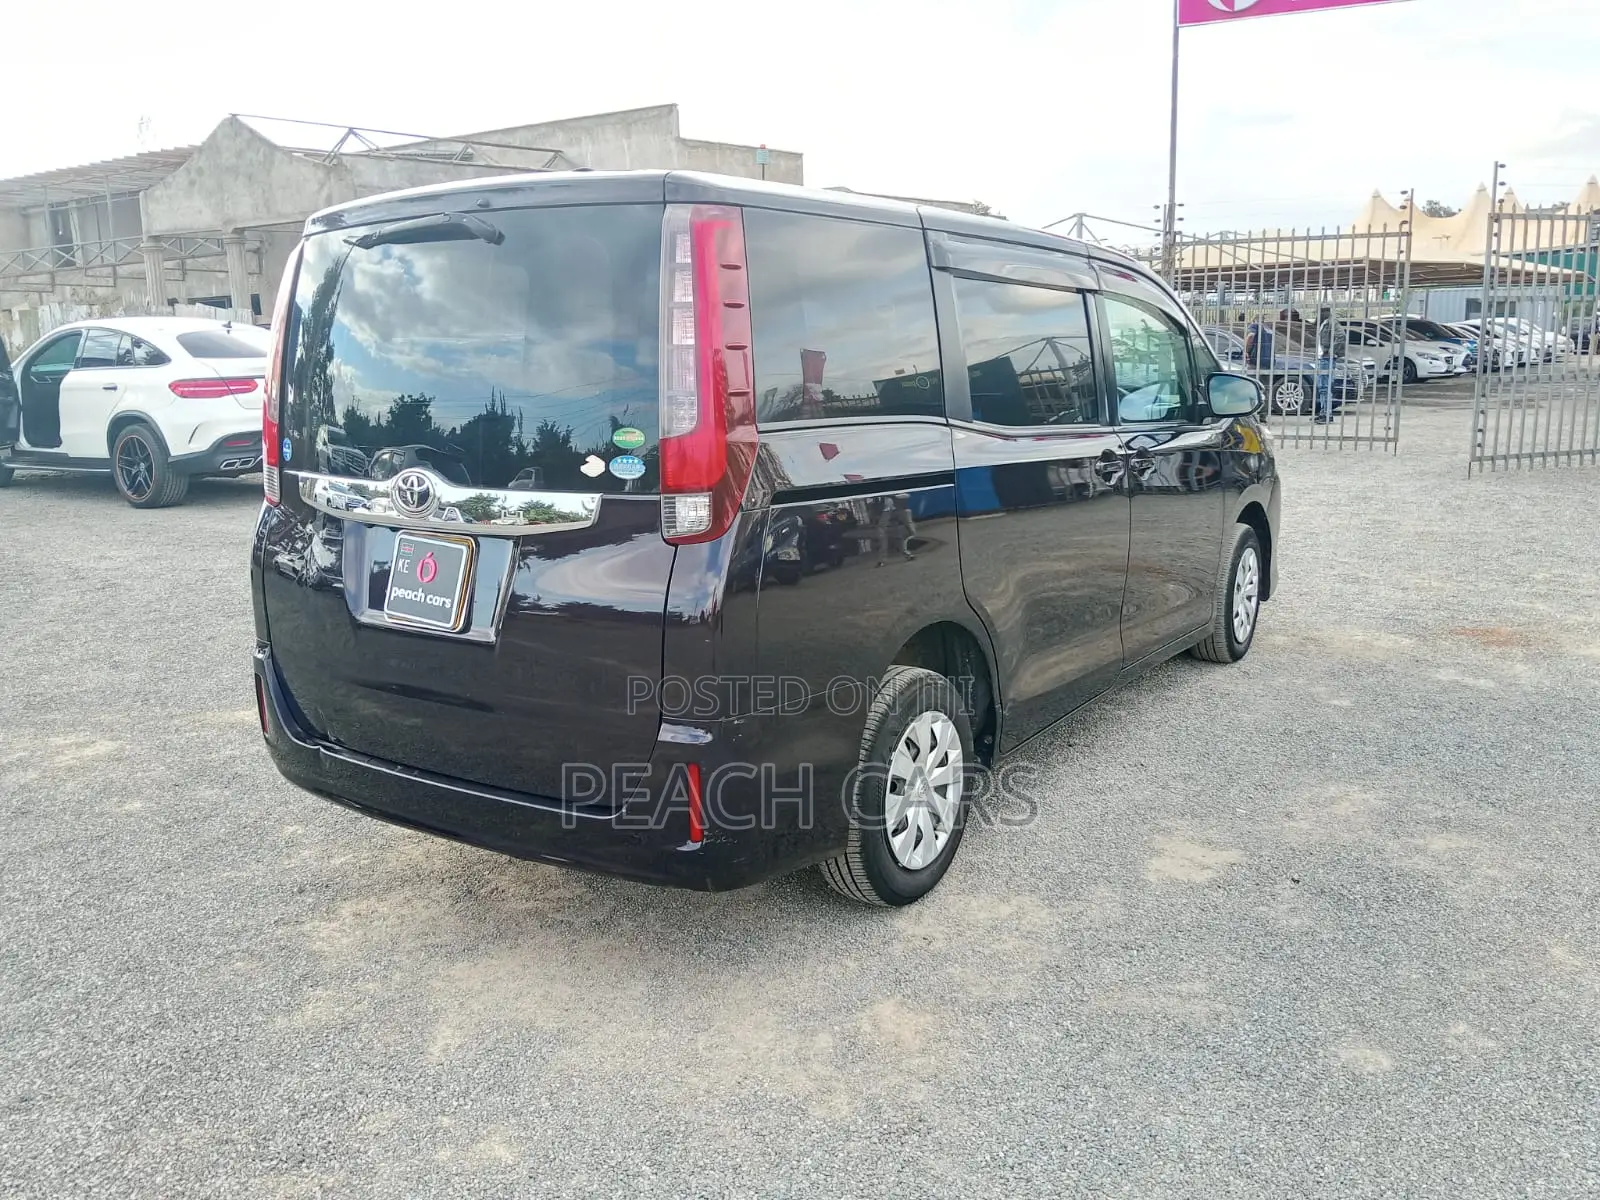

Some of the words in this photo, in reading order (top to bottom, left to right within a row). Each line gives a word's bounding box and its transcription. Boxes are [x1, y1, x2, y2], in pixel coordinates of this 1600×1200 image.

[397, 558, 411, 573] KE
[390, 586, 425, 603] peach
[426, 593, 452, 609] cars
